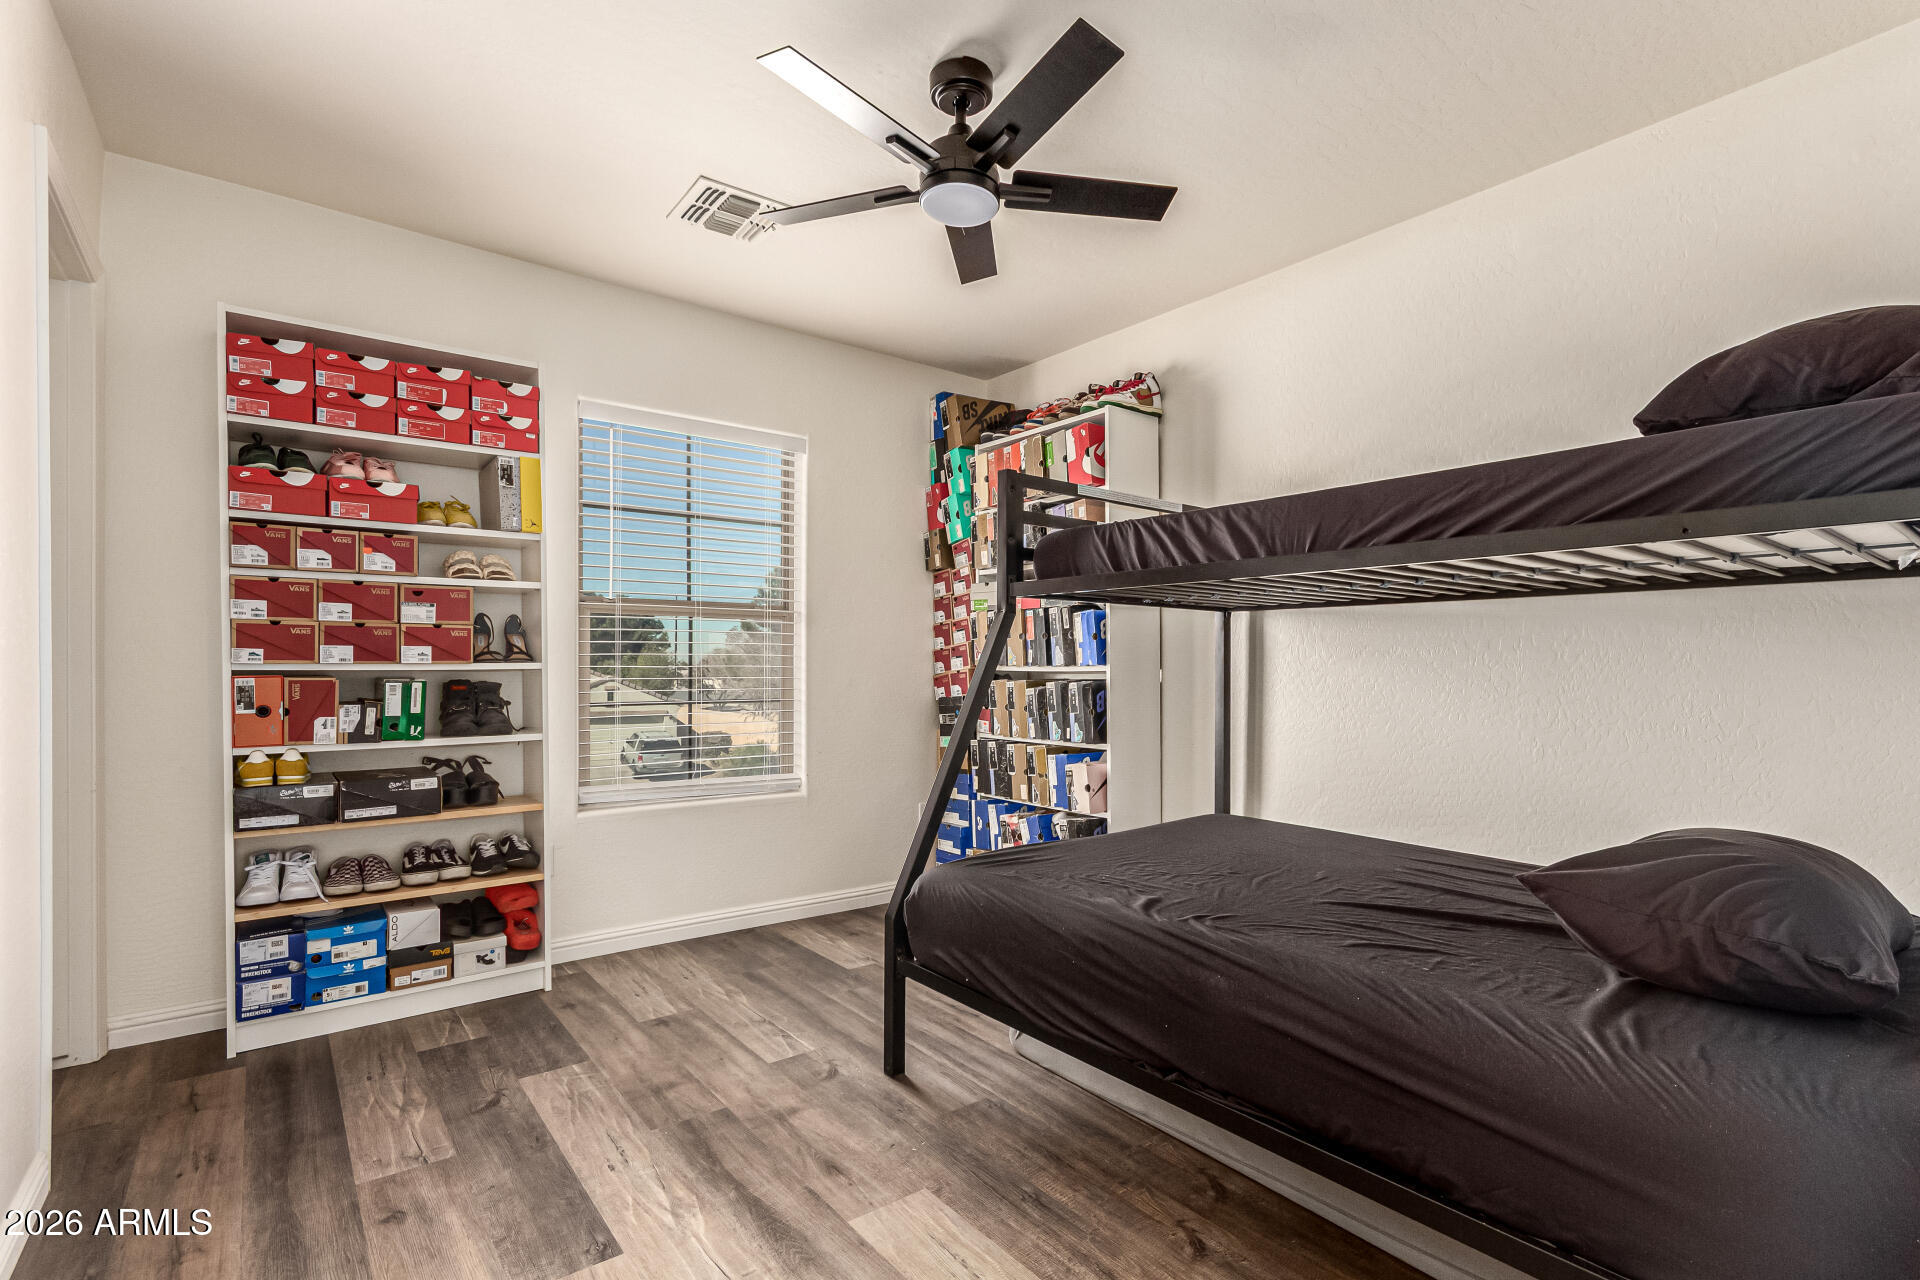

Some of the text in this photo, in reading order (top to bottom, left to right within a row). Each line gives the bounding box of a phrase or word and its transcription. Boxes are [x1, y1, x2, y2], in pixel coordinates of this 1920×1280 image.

[264, 530, 286, 539] VANS
[331, 535, 352, 544] VANS
[391, 540, 411, 548] VANS
[288, 584, 310, 592] VANS
[371, 587, 391, 595] VANS
[449, 591, 467, 599] VANS
[290, 627, 312, 635] VANS
[373, 628, 392, 636] VANS
[450, 629, 468, 637] VANS
[291, 683, 301, 701] VANS
[391, 915, 399, 942] ALDO
